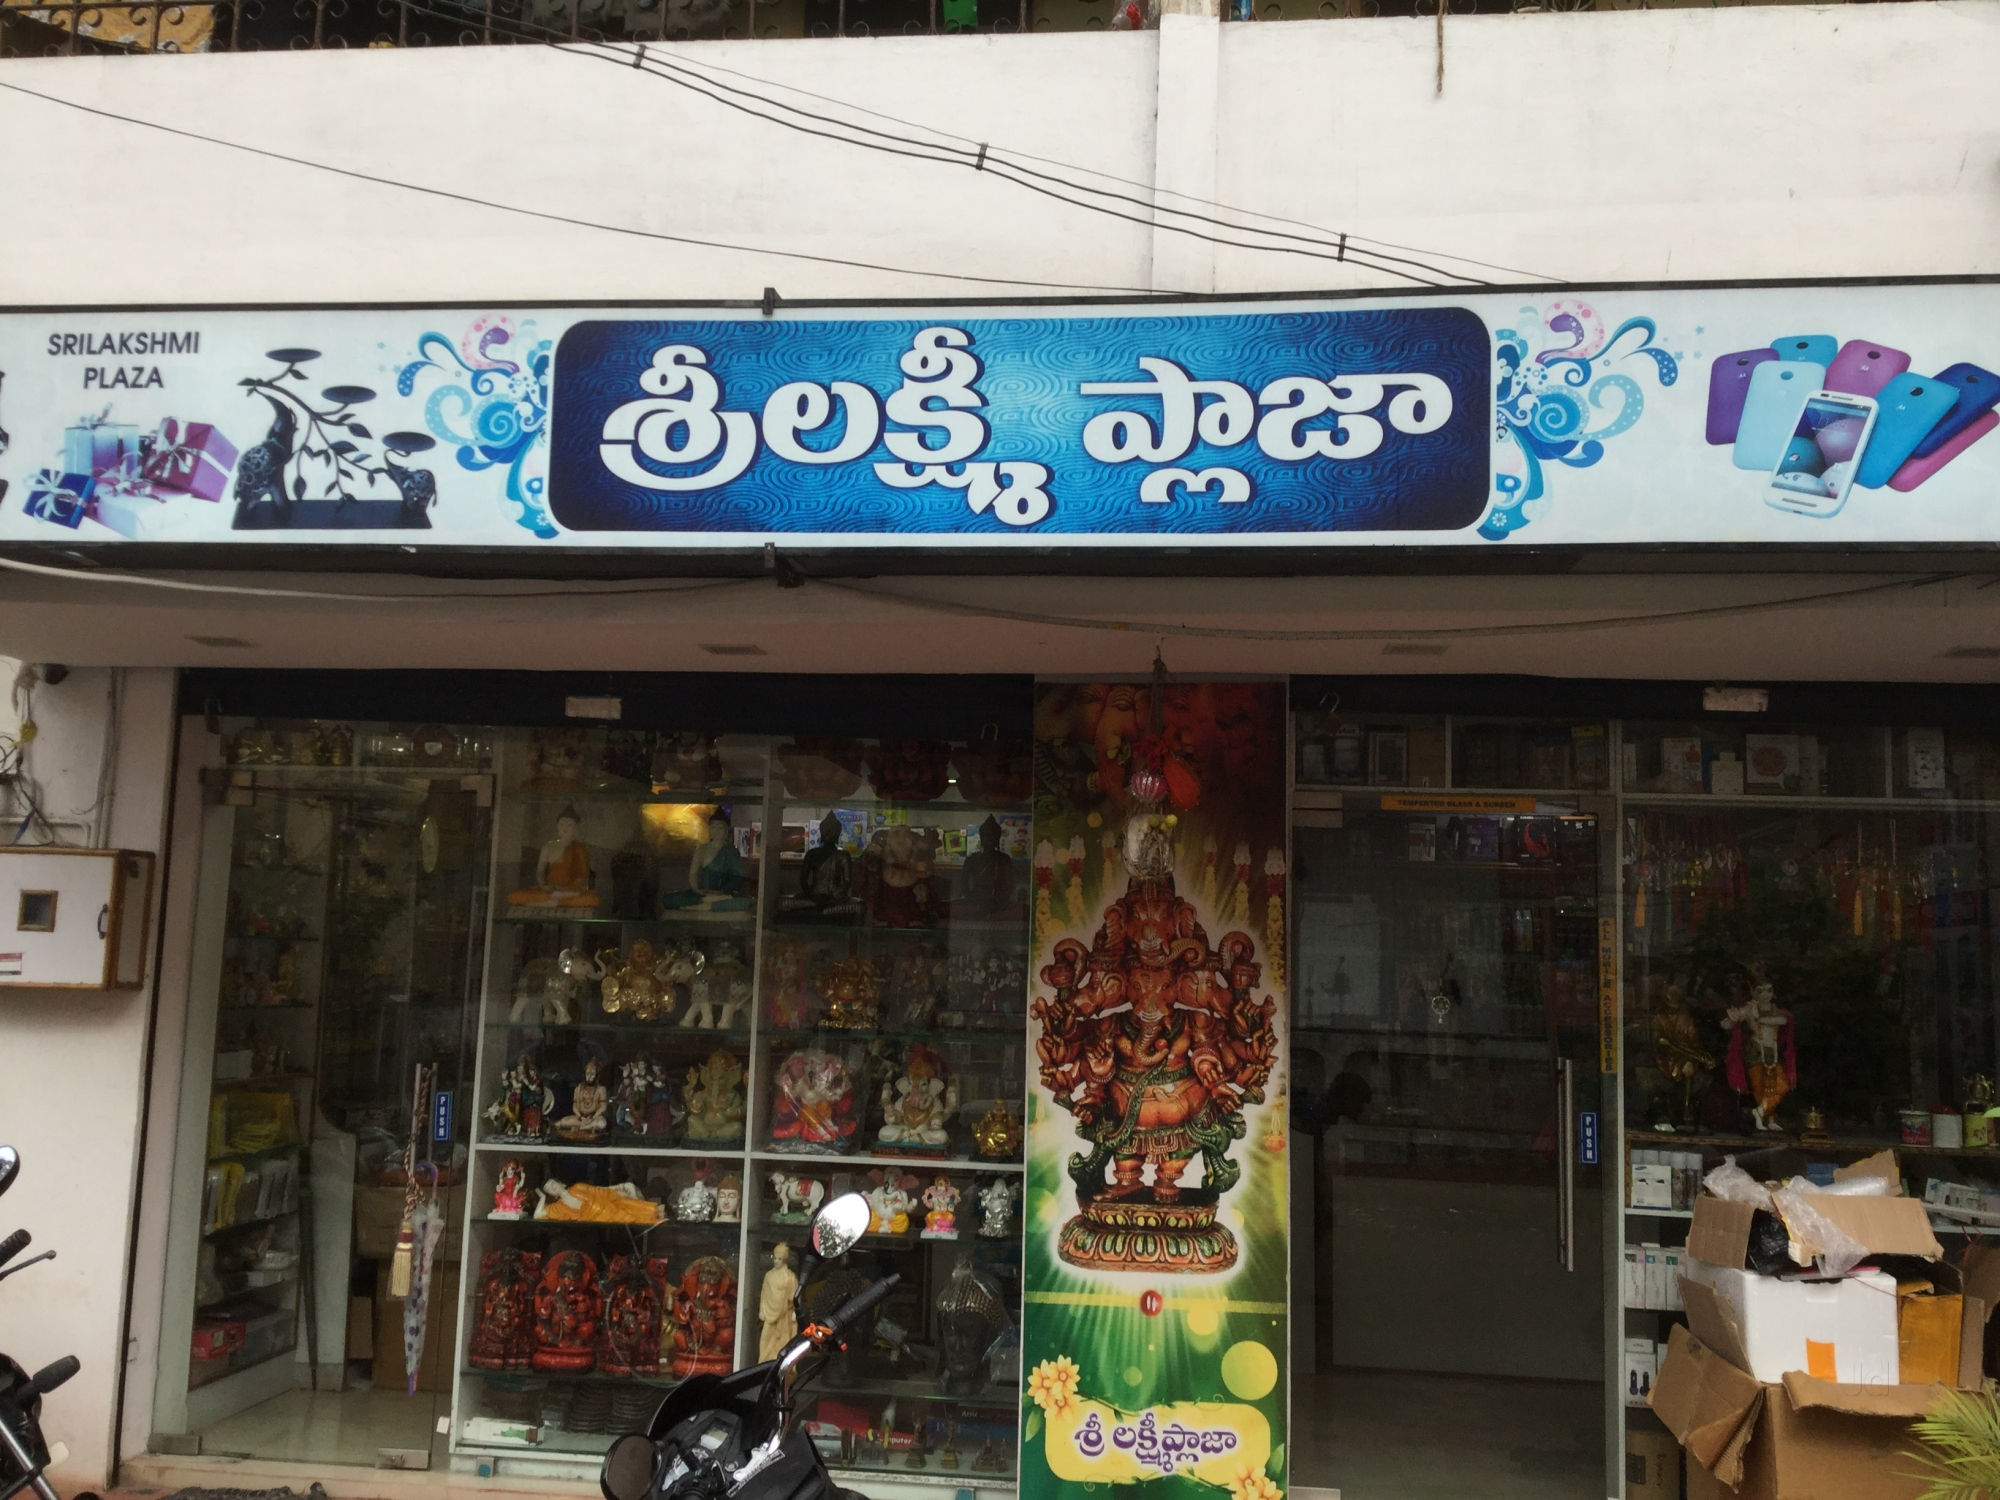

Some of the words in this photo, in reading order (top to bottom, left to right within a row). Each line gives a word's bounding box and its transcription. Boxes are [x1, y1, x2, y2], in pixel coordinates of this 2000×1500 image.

[47, 331, 200, 357] SRILAKSHMI
[83, 367, 164, 389] PLAZA
[1081, 357, 1453, 504] ప్లాజా
[438, 1096, 446, 1137] PUSH
[1585, 1115, 1593, 1160] PUSH
[1074, 1412, 1105, 1457] శ్రీ
